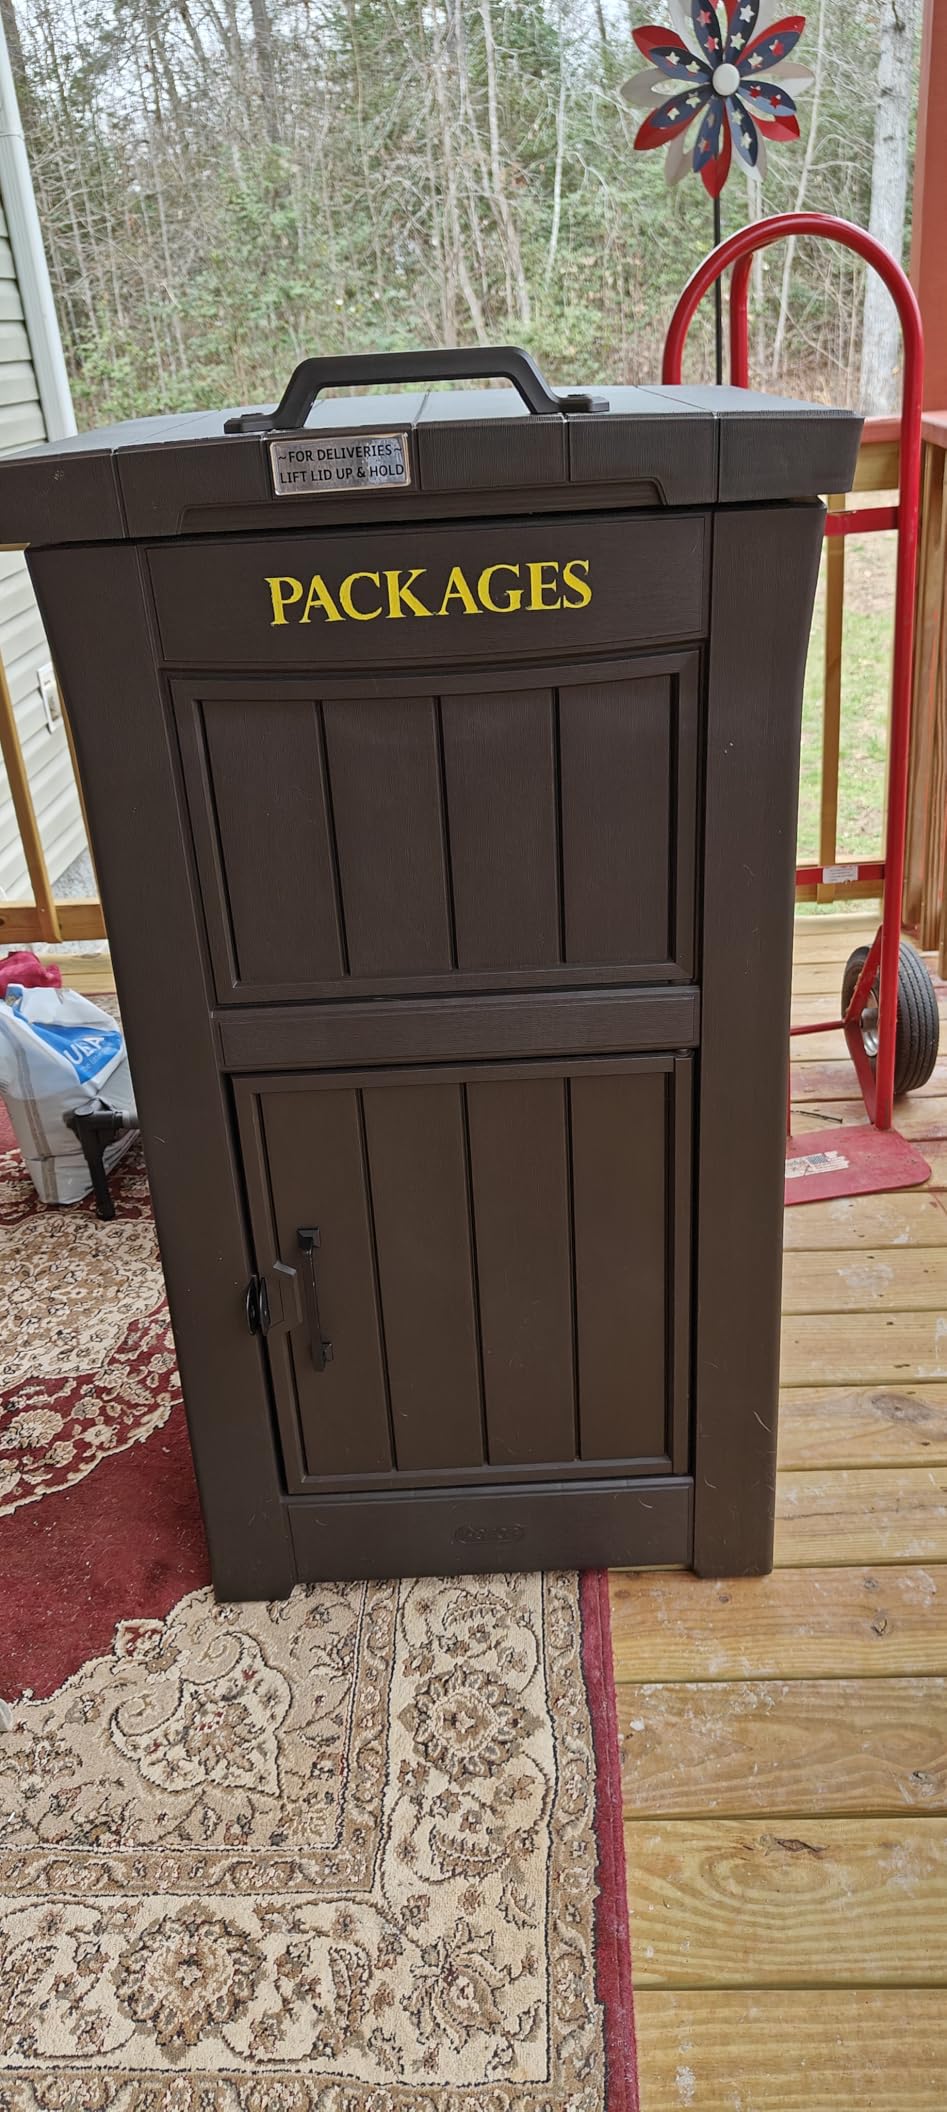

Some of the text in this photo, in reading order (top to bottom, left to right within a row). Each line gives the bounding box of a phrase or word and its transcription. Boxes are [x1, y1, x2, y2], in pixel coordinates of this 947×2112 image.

[280, 464, 404, 484] LIFT LID UP & HOLD
[264, 560, 592, 626] PACKAGES
